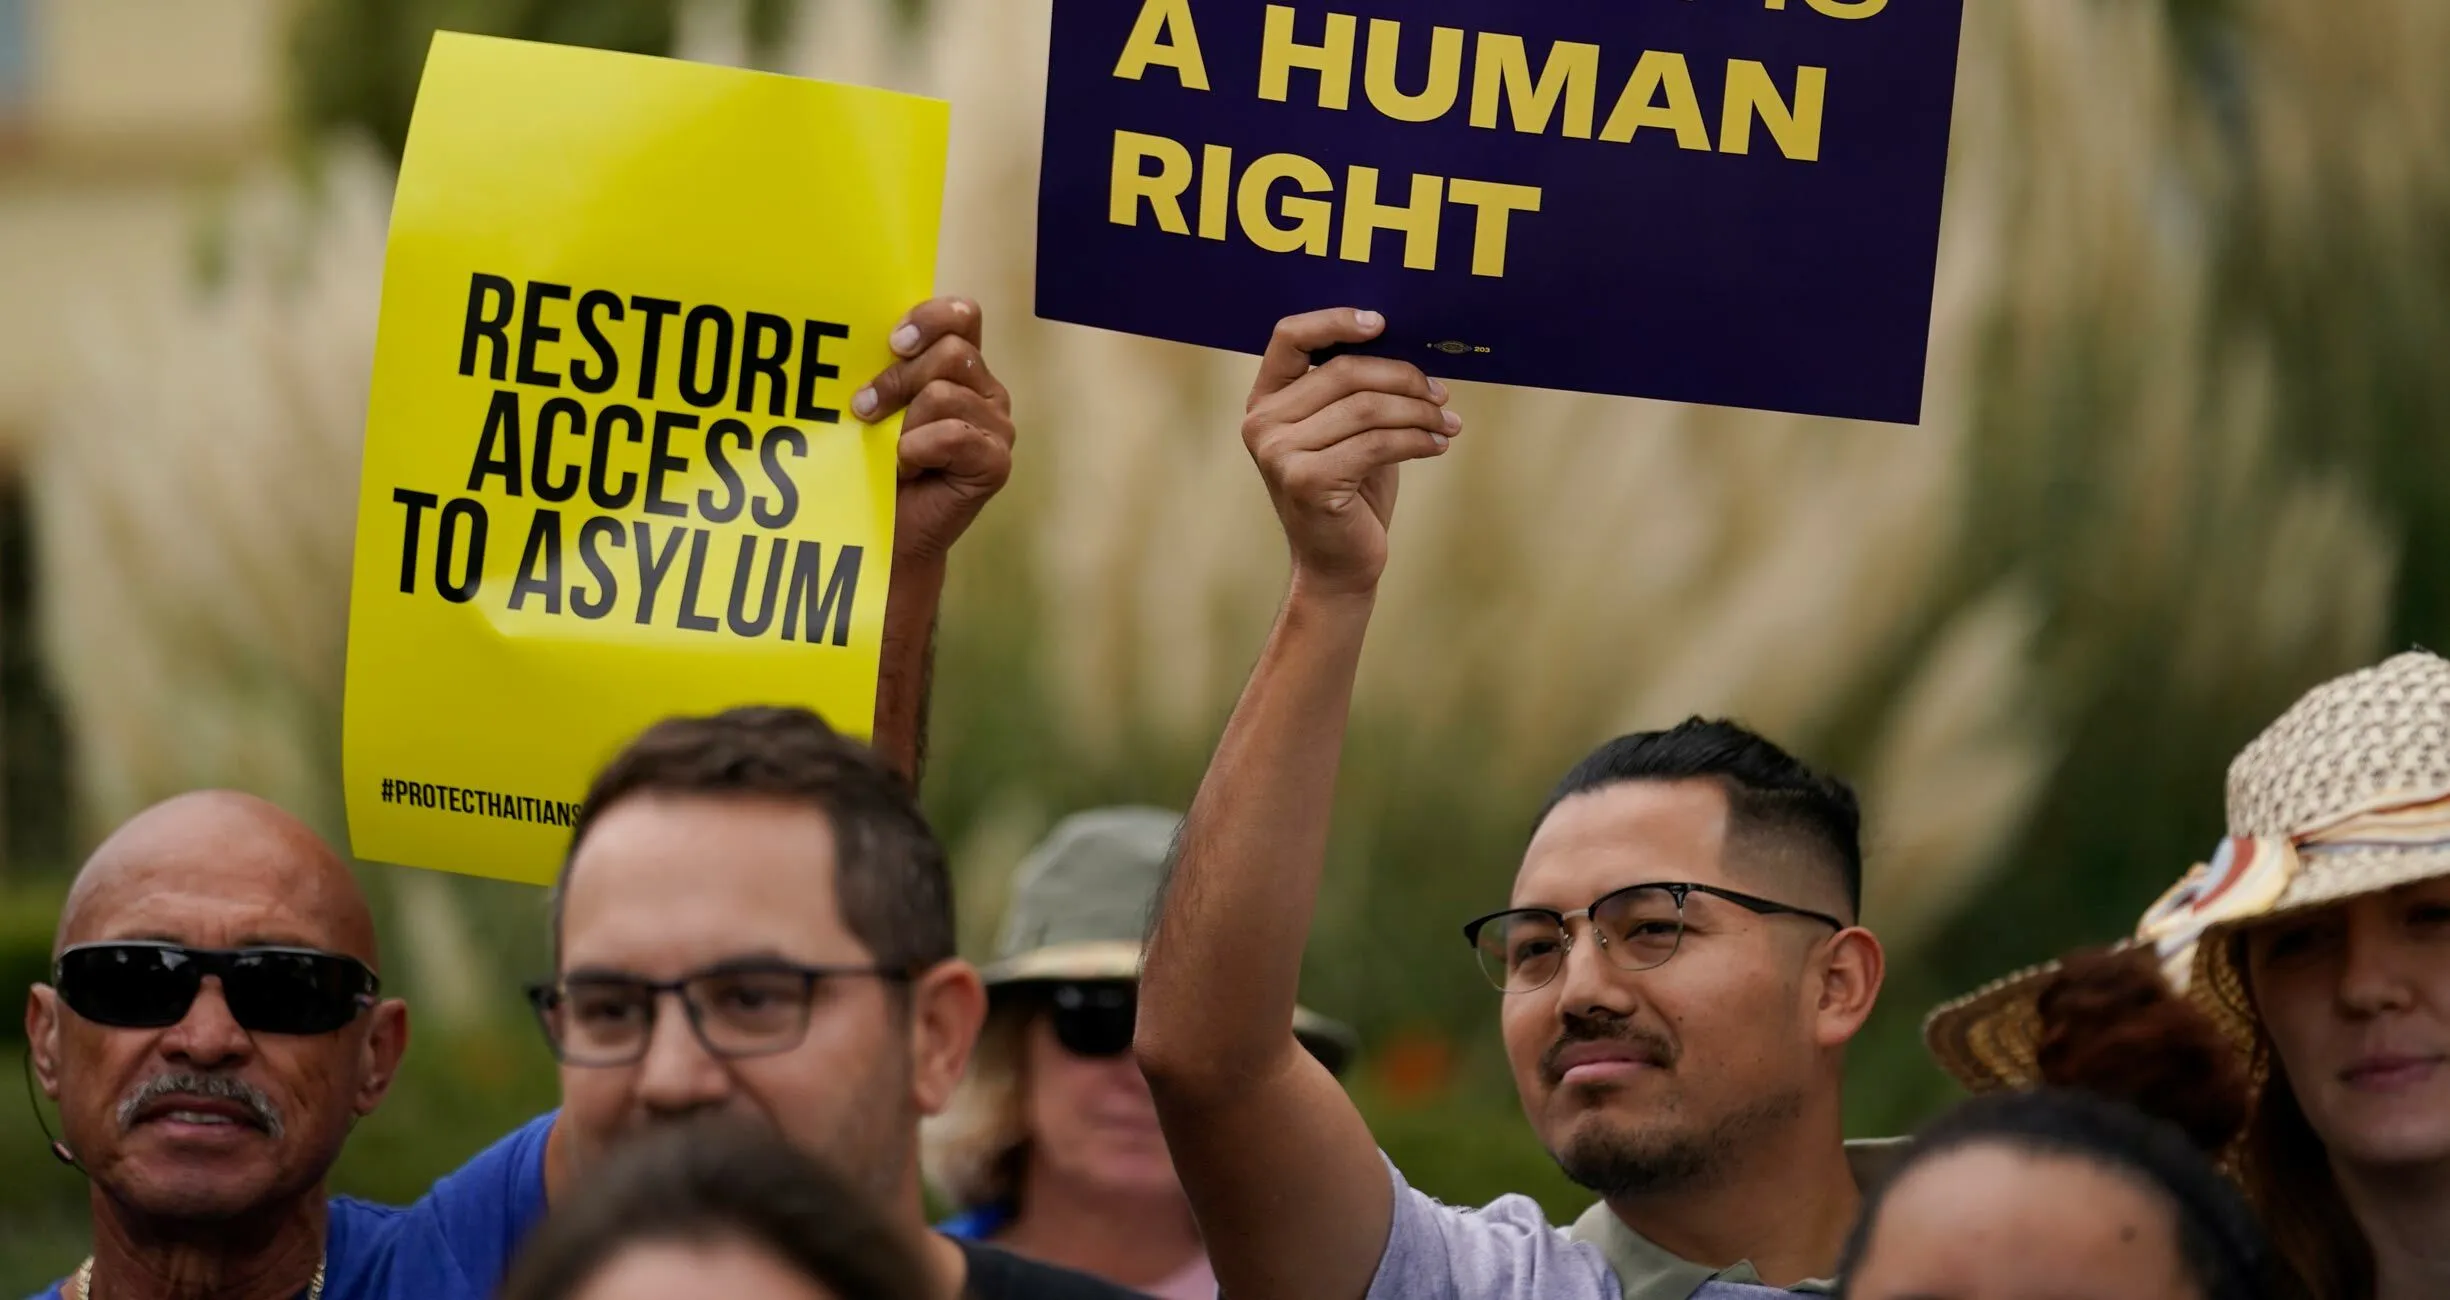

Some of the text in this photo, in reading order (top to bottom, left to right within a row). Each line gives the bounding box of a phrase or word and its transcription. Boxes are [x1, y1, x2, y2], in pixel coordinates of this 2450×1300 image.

[1112, 0, 1827, 162] A HUMAN
[1109, 129, 1542, 278] RIGHT
[458, 272, 850, 425] RESTORE
[465, 389, 807, 530] ACCESS
[392, 487, 864, 647] TO ASYLUM
